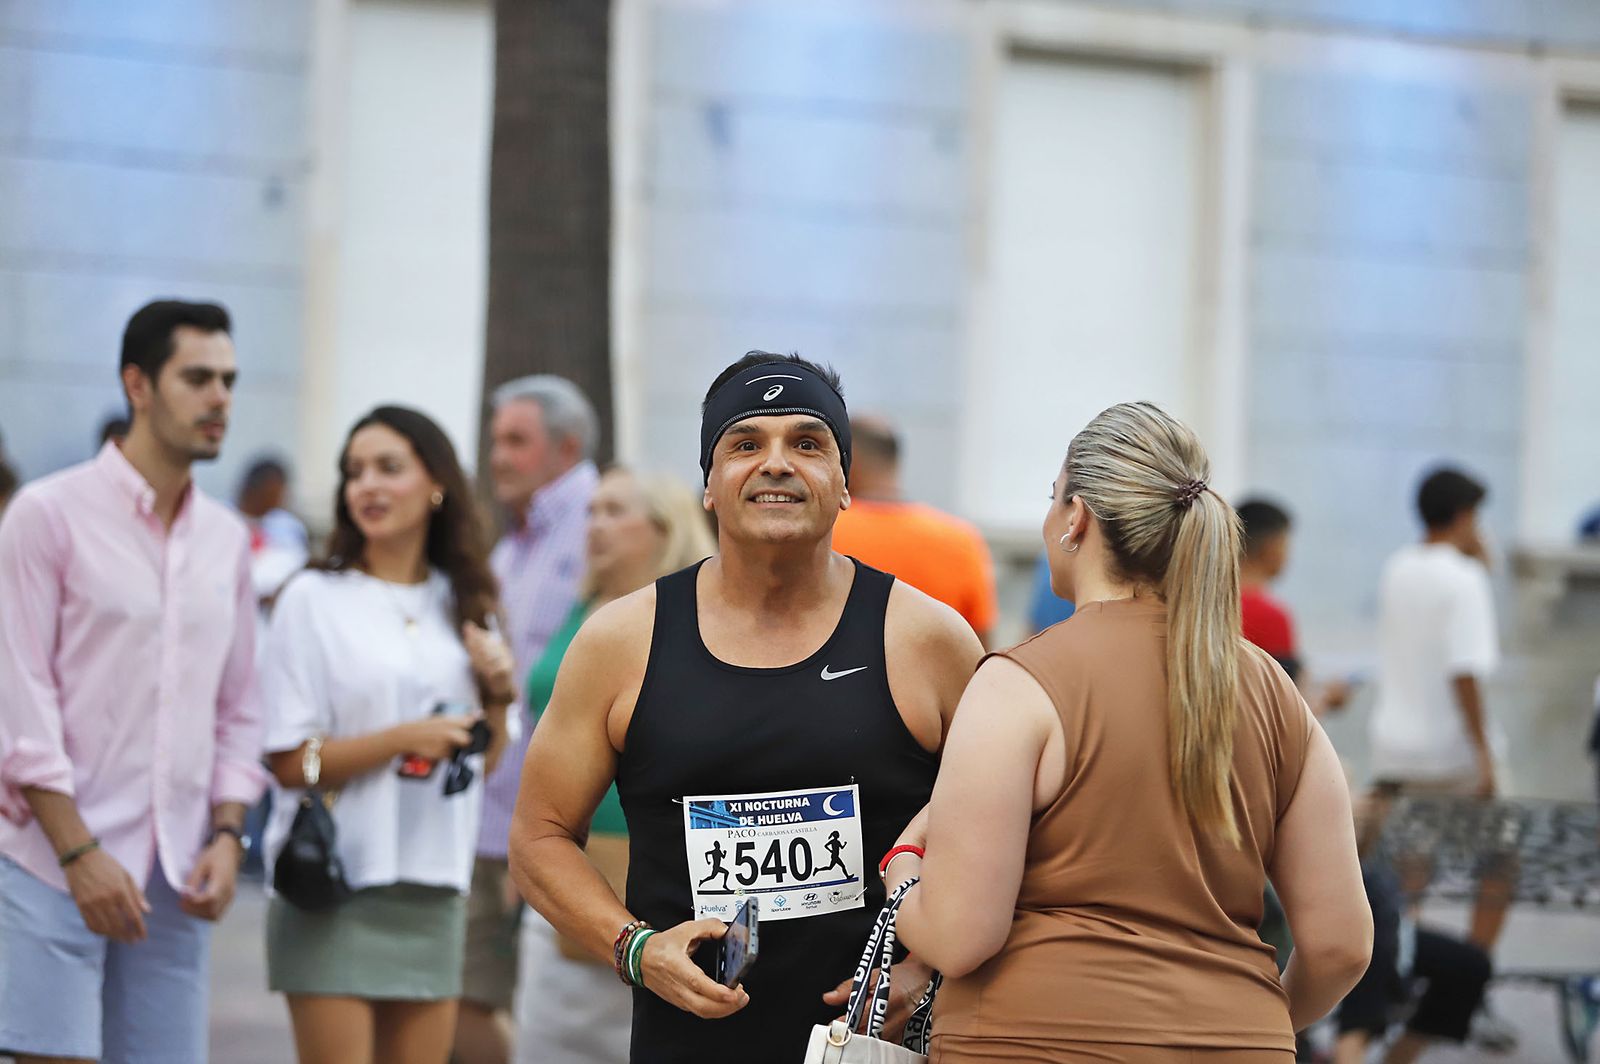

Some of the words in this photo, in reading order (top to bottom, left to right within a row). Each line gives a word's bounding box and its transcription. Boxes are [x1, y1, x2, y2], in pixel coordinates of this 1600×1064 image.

[729, 802, 742, 813] XI
[744, 797, 811, 812] NOCTURNA
[739, 816, 755, 826] DE
[758, 811, 804, 825] HUELVA
[727, 828, 756, 839] PACO
[790, 826, 818, 835] CASTILLA
[735, 837, 813, 886] 540
[701, 904, 726, 913] Huelva
